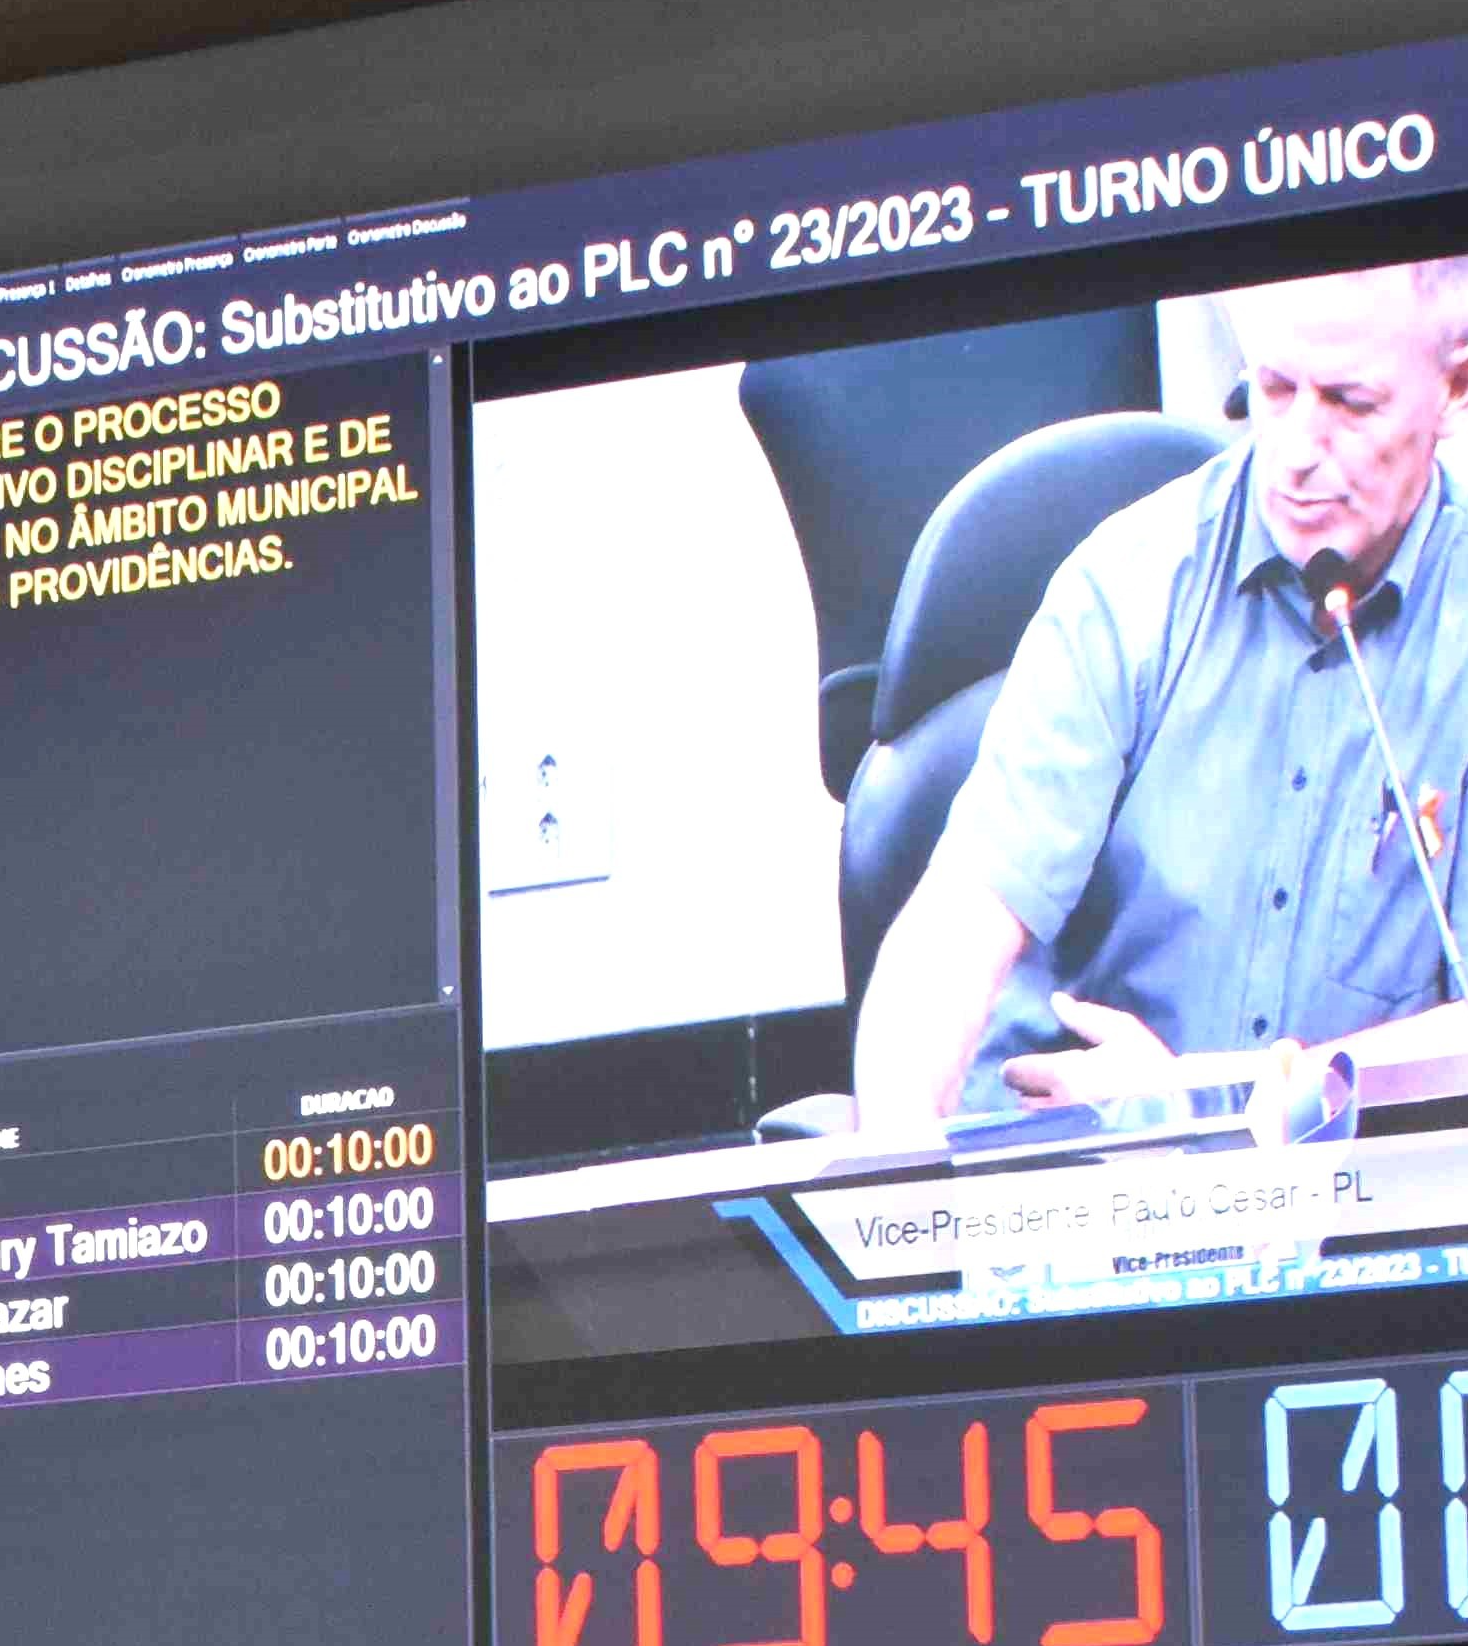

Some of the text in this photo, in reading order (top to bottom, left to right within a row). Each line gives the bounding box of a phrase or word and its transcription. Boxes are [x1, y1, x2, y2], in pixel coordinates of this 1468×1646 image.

[221, 269, 496, 354] Substitutivo
[508, 262, 570, 308] ao
[584, 230, 688, 299] PLC
[770, 184, 974, 269] 23/2023
[987, 207, 1009, 221] -
[1021, 148, 1229, 228] TURNO
[1244, 113, 1435, 184] ÚNICO
[34, 414, 64, 452] O
[74, 381, 281, 448] PROCESSO
[67, 430, 294, 500] DISCIPLINAR
[304, 425, 330, 463] E
[339, 415, 392, 458] DE
[5, 516, 59, 559] NO
[67, 495, 208, 550] ÂMBITO
[217, 465, 419, 528] MUNICIPAL
[10, 534, 293, 609] PROVIDÊNCIAS.
[264, 1124, 434, 1181] 00:10:00
[45, 1216, 208, 1267] Tamiazo
[264, 1187, 434, 1244] 00:10:00
[855, 1204, 1090, 1250] Vice-Presidene
[1111, 1188, 1196, 1227] Pauo
[1333, 1170, 1375, 1204] PL
[265, 1250, 436, 1307] 00:10:00
[265, 1313, 437, 1371] 00:10:00
